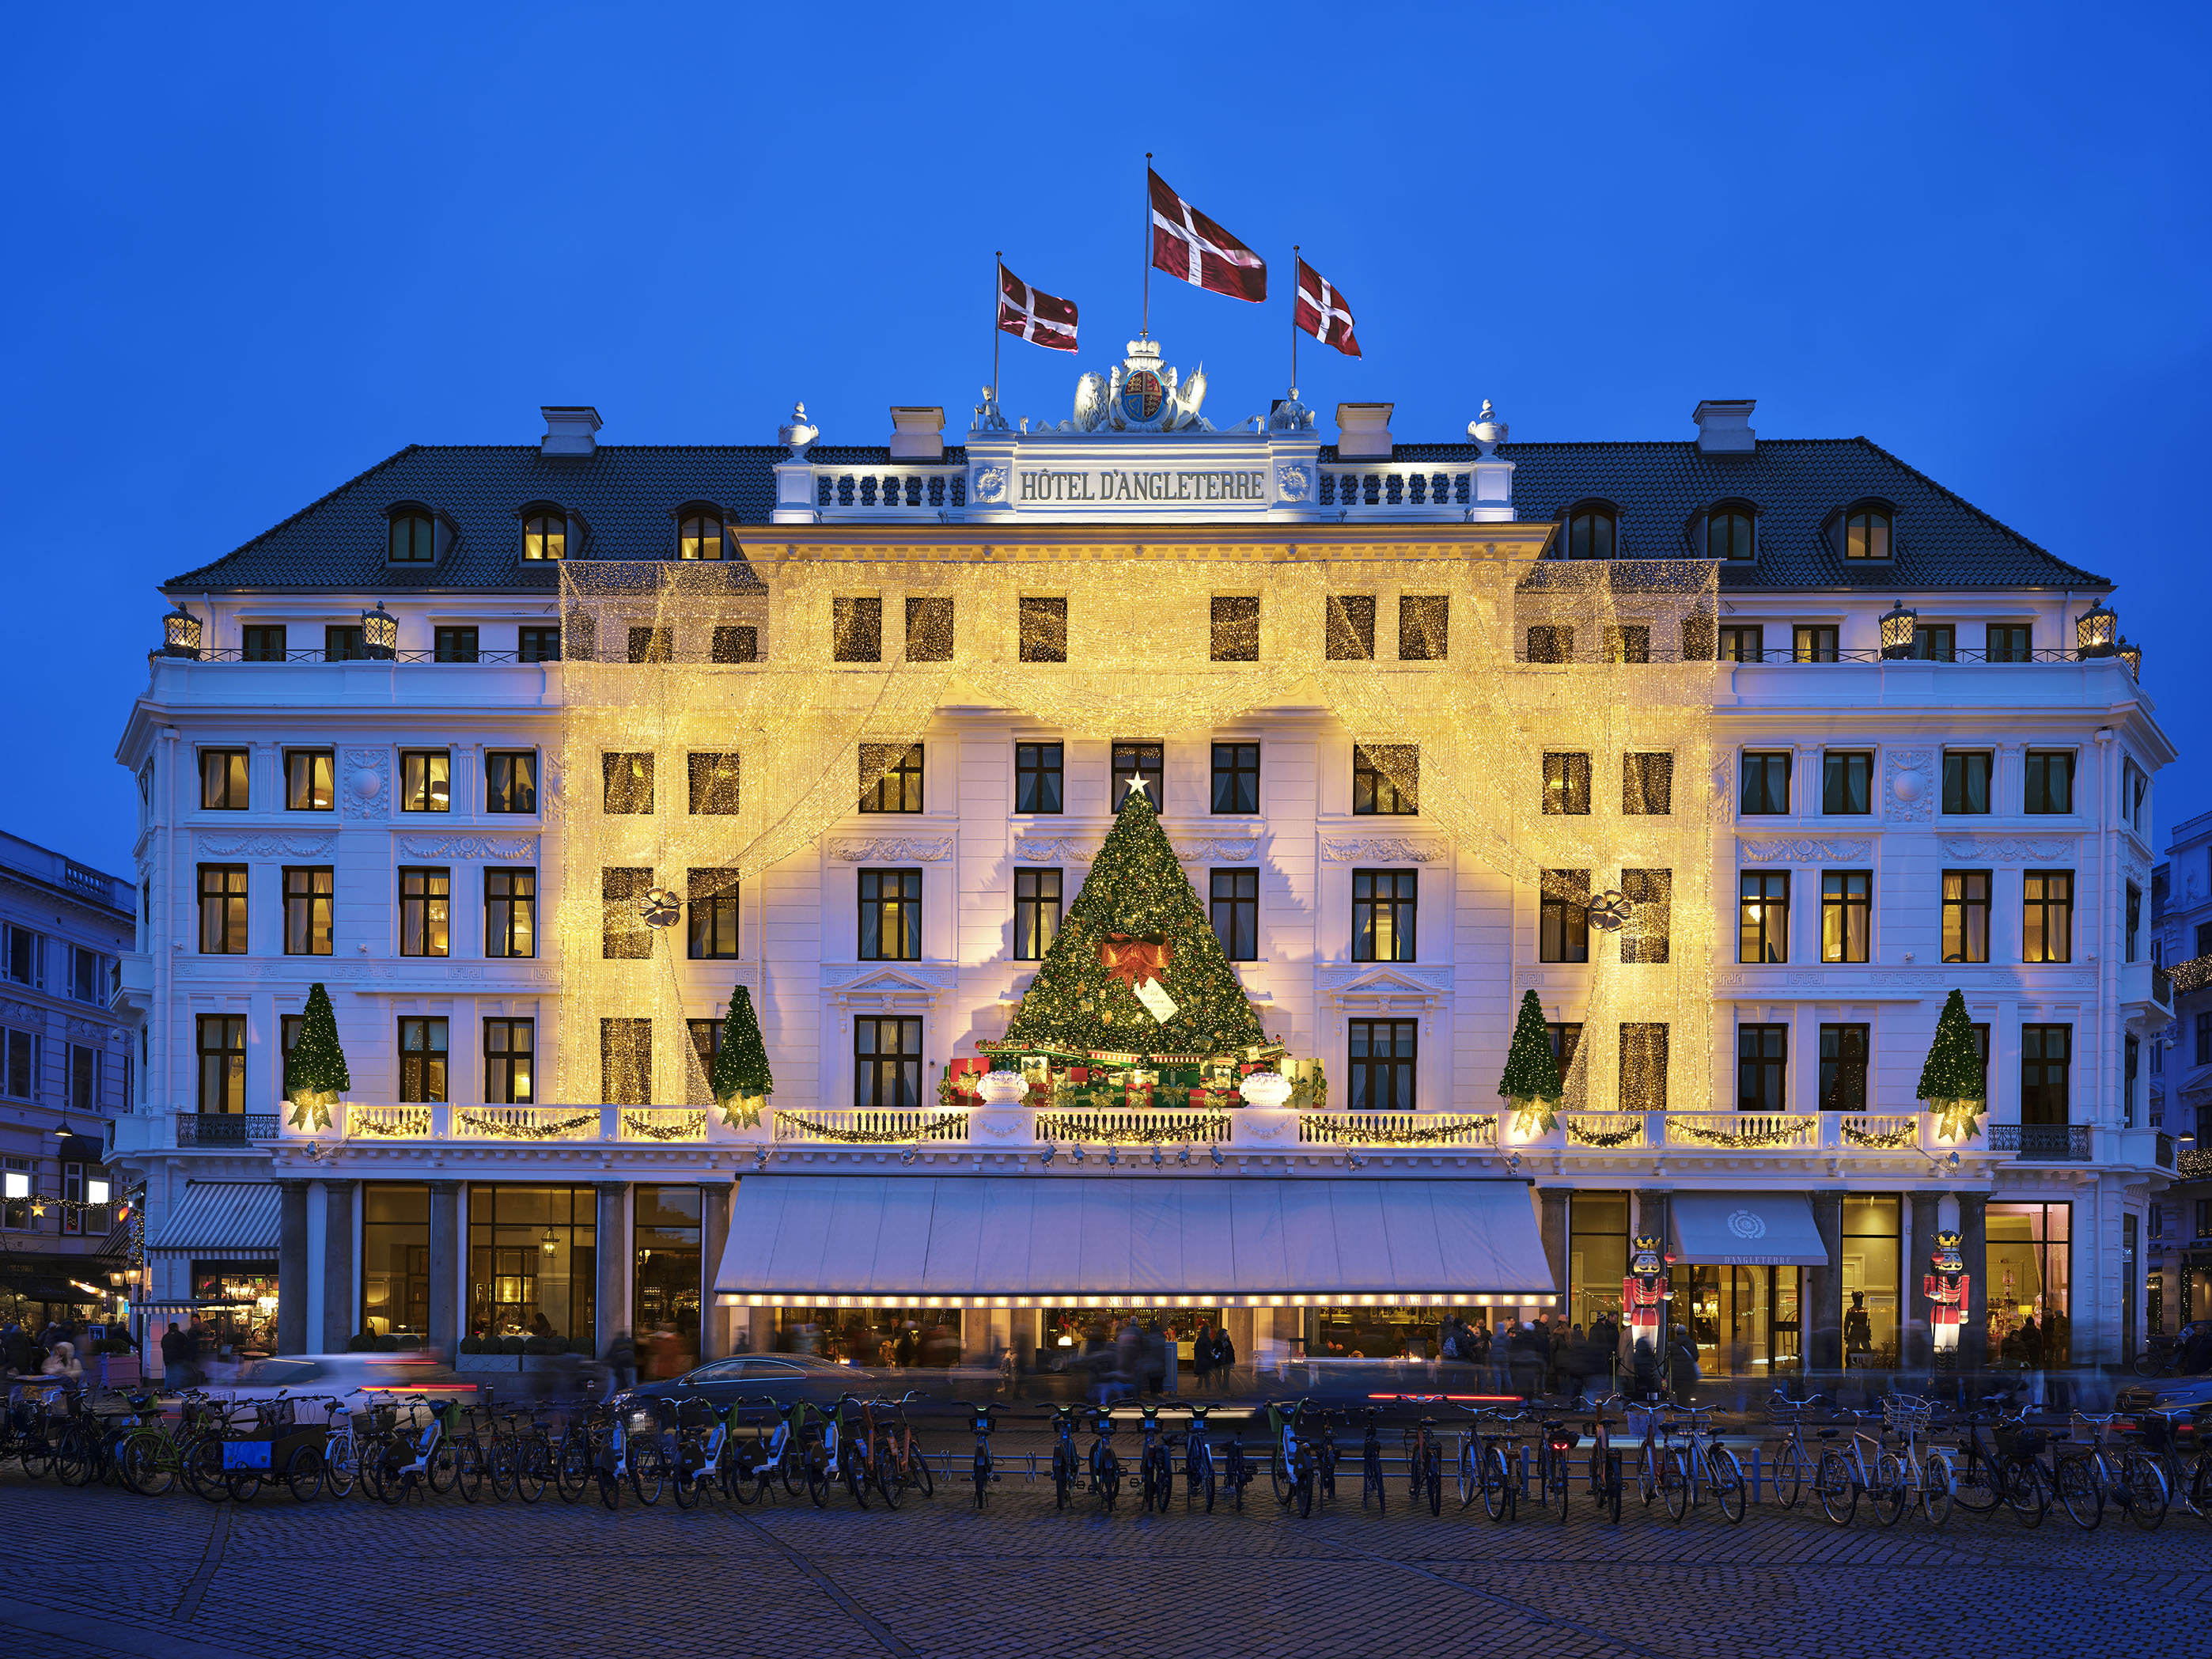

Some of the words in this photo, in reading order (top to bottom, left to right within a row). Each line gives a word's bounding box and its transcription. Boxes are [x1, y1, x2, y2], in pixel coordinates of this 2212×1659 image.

[1020, 468, 1095, 500] HÔTEL
[1100, 468, 1264, 500] D'ANGLETERRE
[1724, 1256, 1791, 1264] D'ANGLETERRE
[818, 1297, 865, 1306] ARCHAL
